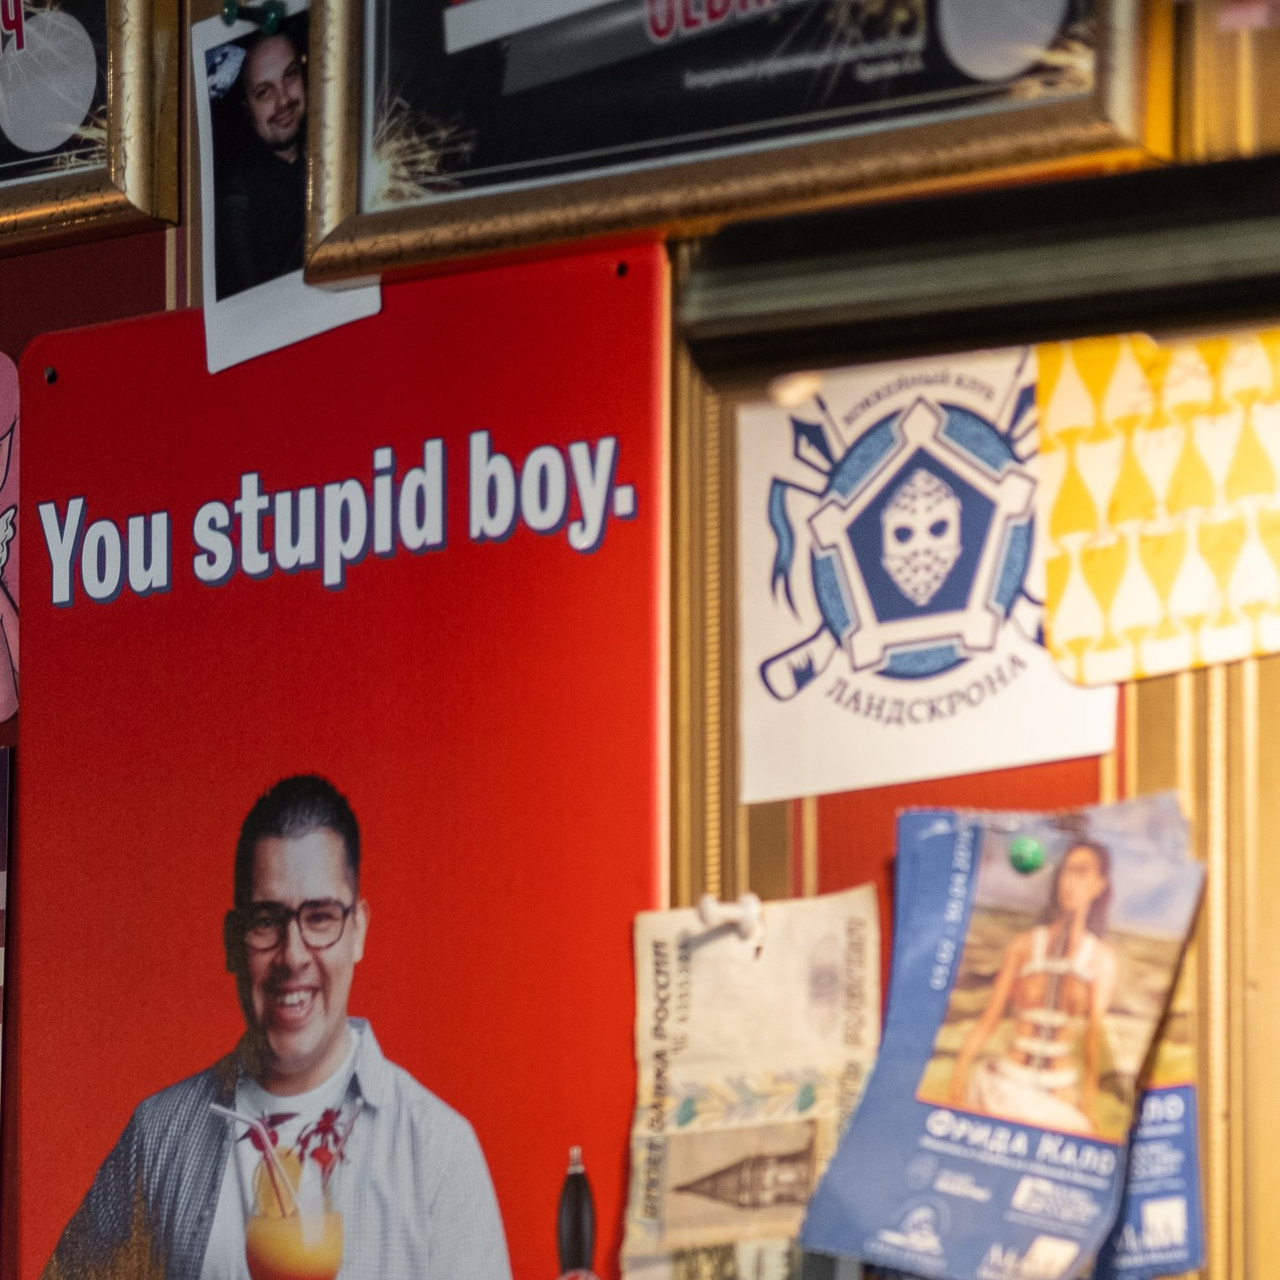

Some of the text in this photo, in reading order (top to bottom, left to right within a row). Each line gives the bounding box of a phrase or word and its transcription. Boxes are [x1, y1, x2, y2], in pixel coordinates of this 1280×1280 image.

[37, 429, 637, 608] You stupid boy.
[824, 653, 1028, 727] ЛАНДСКРОНА
